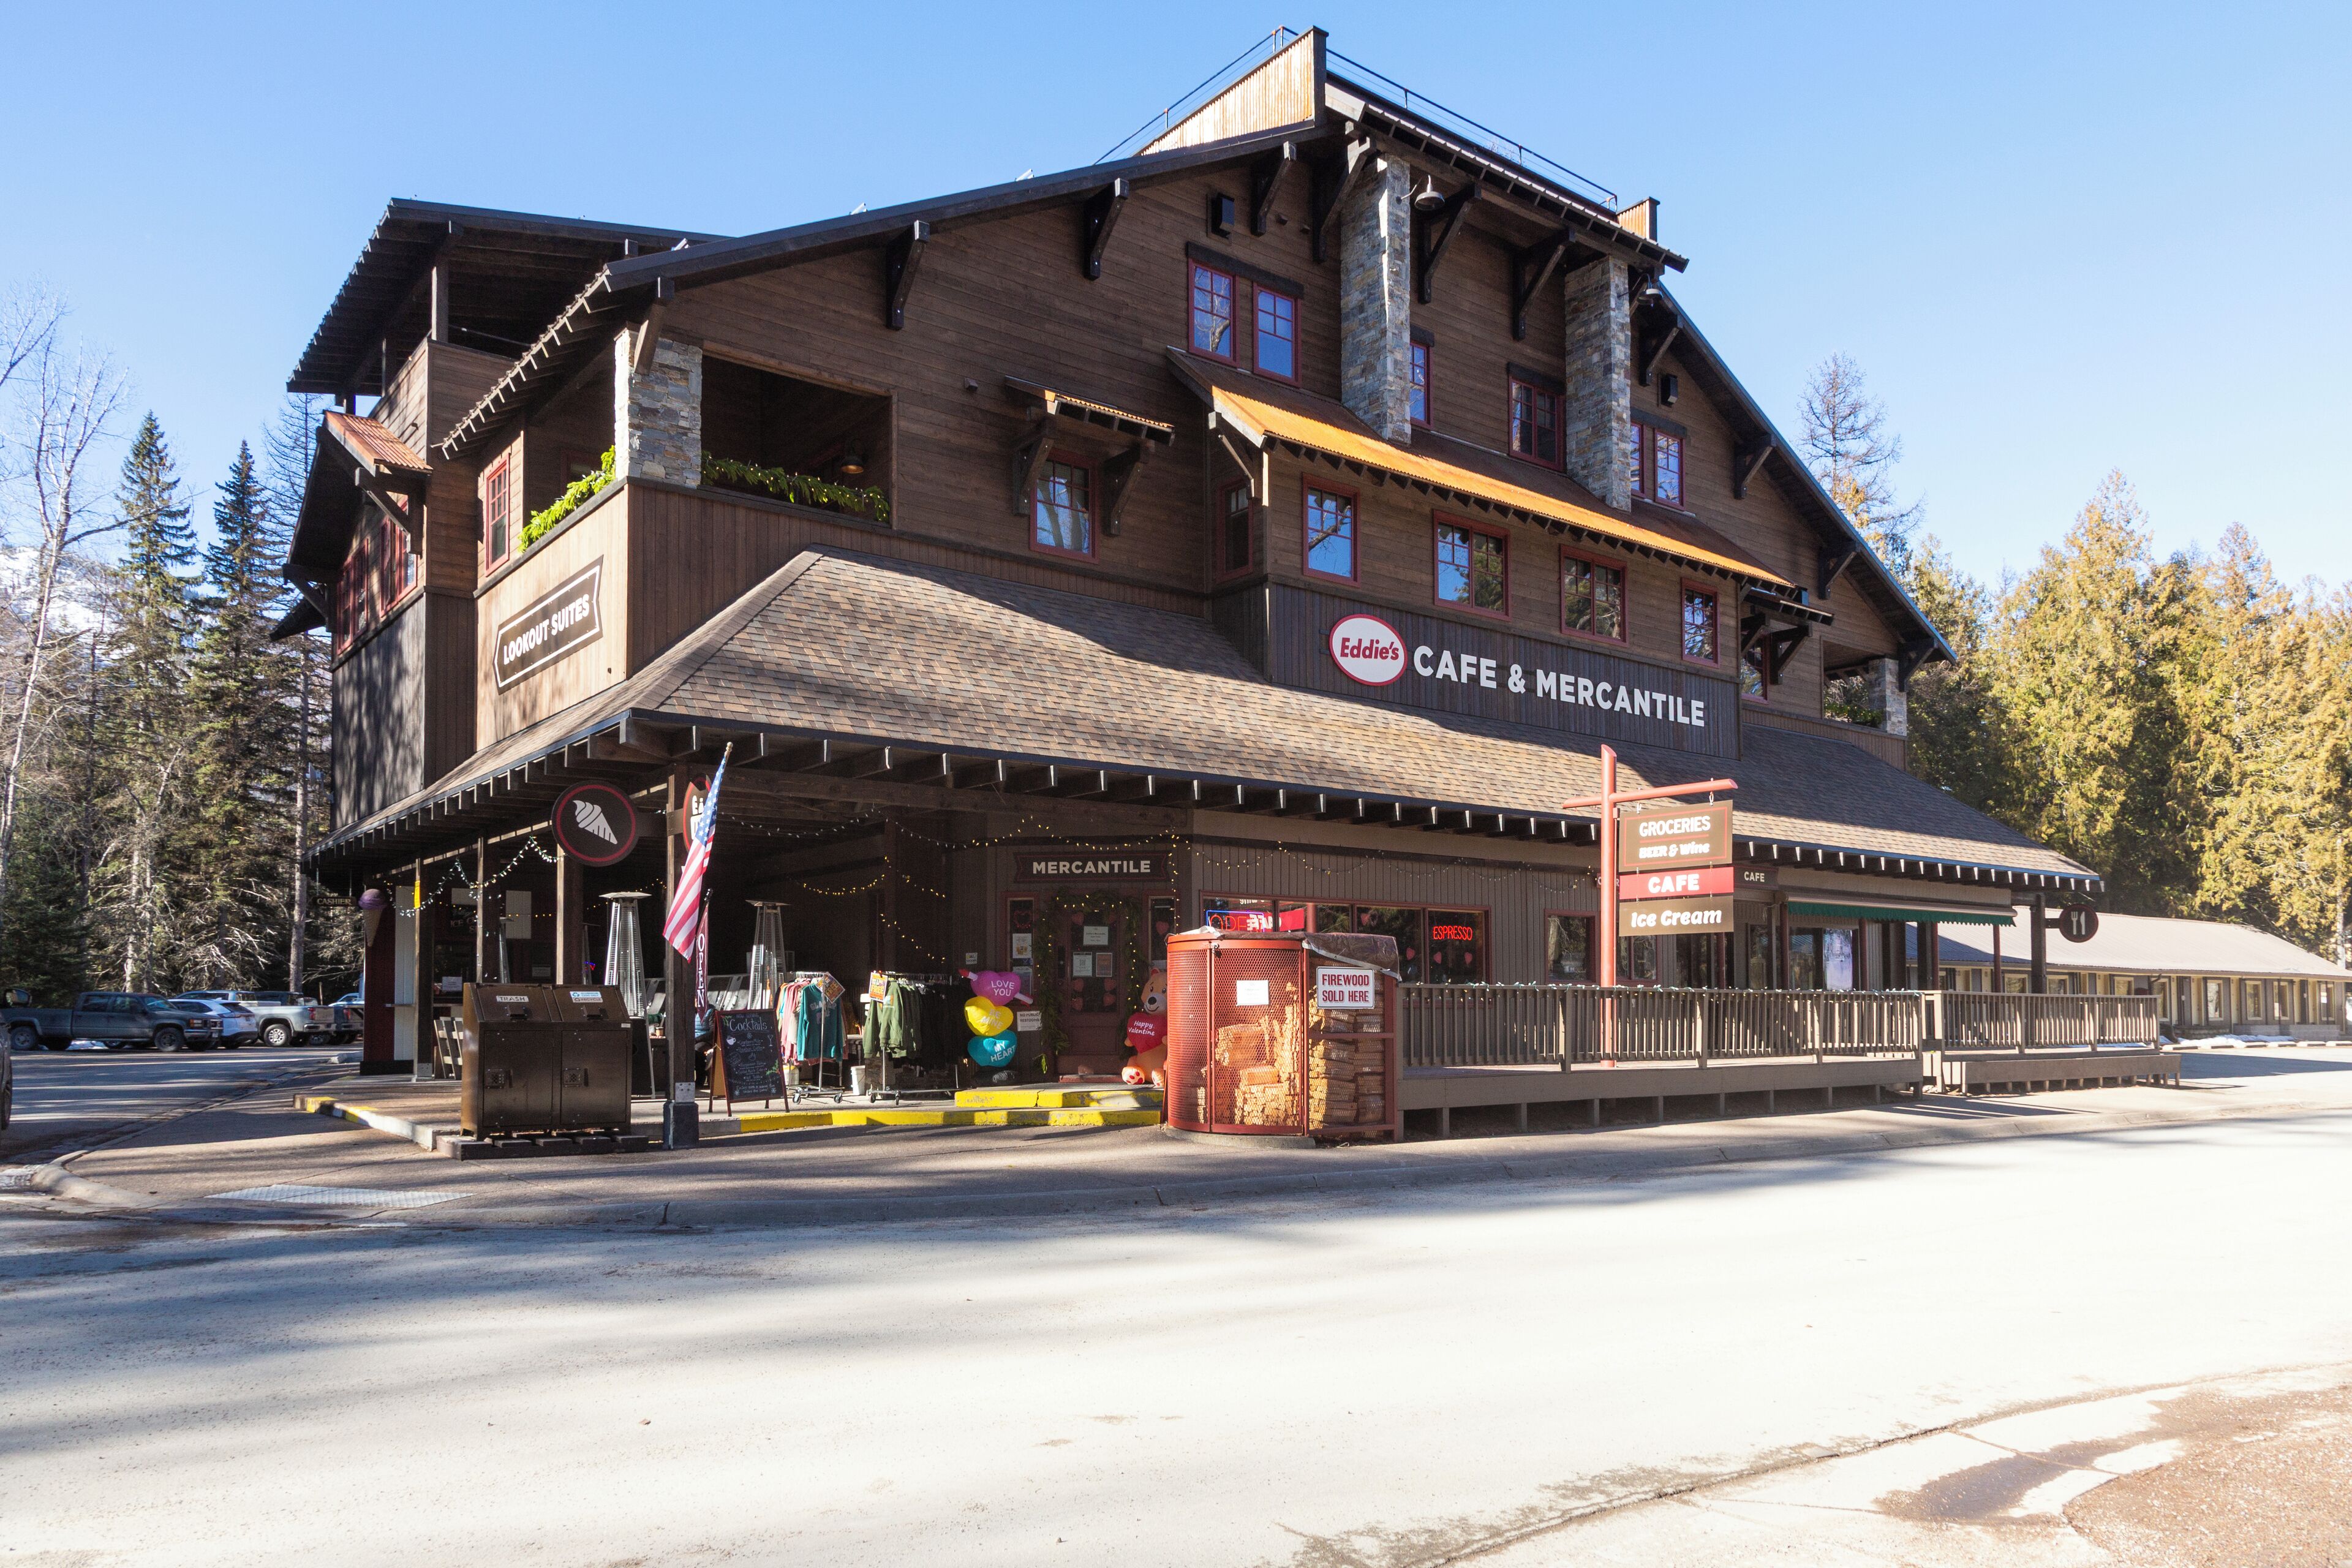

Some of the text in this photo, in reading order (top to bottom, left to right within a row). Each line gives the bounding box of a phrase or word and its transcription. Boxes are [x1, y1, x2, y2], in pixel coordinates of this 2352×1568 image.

[503, 594, 589, 665] LOOKOUT SUITES
[1340, 636, 1400, 661] Eddie's
[1413, 645, 1705, 727] CAFE & MERCANTILE
[1639, 815, 1711, 837] GROCERIES
[1638, 845, 1668, 859] BEER
[1668, 843, 1678, 858] &
[1033, 860, 1151, 874] MERCANTILE
[1648, 873, 1700, 894] CAFE
[1744, 871, 1765, 883] CAFE
[1631, 908, 1722, 928] Ice Cream
[1433, 925, 1473, 941] ESPRESSO
[991, 980, 1015, 989] LOVE
[1322, 974, 1370, 986] FIREWOOD
[824, 982, 839, 995] FREE
[1322, 990, 1369, 1001] SOLD HERE
[990, 1009, 1001, 1018] BE
[729, 1017, 767, 1031] Cocktails
[981, 1016, 1003, 1030] MINE
[1134, 1020, 1153, 1029] Happy
[1128, 1027, 1155, 1036] Valentine
[990, 1045, 1016, 1062] HEART
[993, 1041, 1006, 1052] MY
